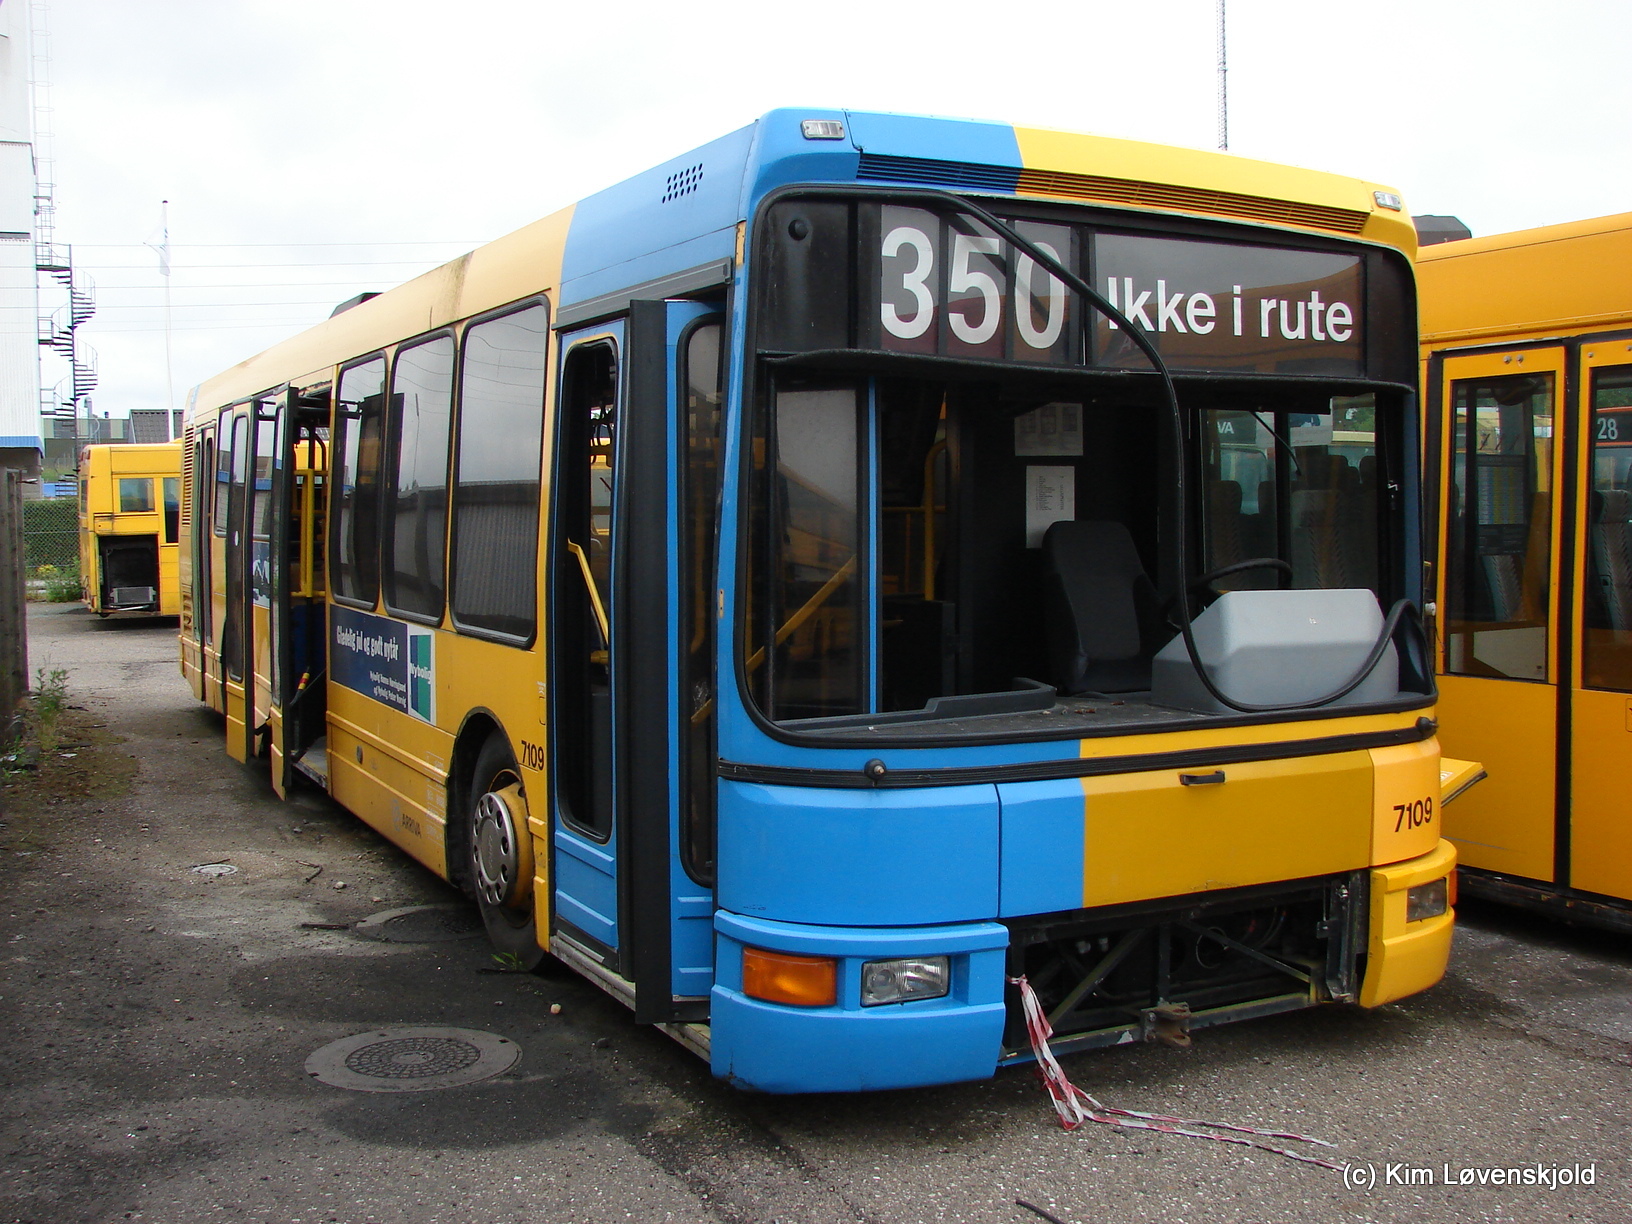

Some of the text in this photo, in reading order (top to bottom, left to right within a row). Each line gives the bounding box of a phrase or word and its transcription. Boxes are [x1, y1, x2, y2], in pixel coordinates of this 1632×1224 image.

[881, 227, 1064, 349] 350
[1107, 276, 1354, 342] Ikke i rute
[1597, 418, 1618, 440] 28
[410, 662, 432, 684] Nybolig
[521, 740, 544, 770] 7109
[1393, 796, 1433, 833] 7109
